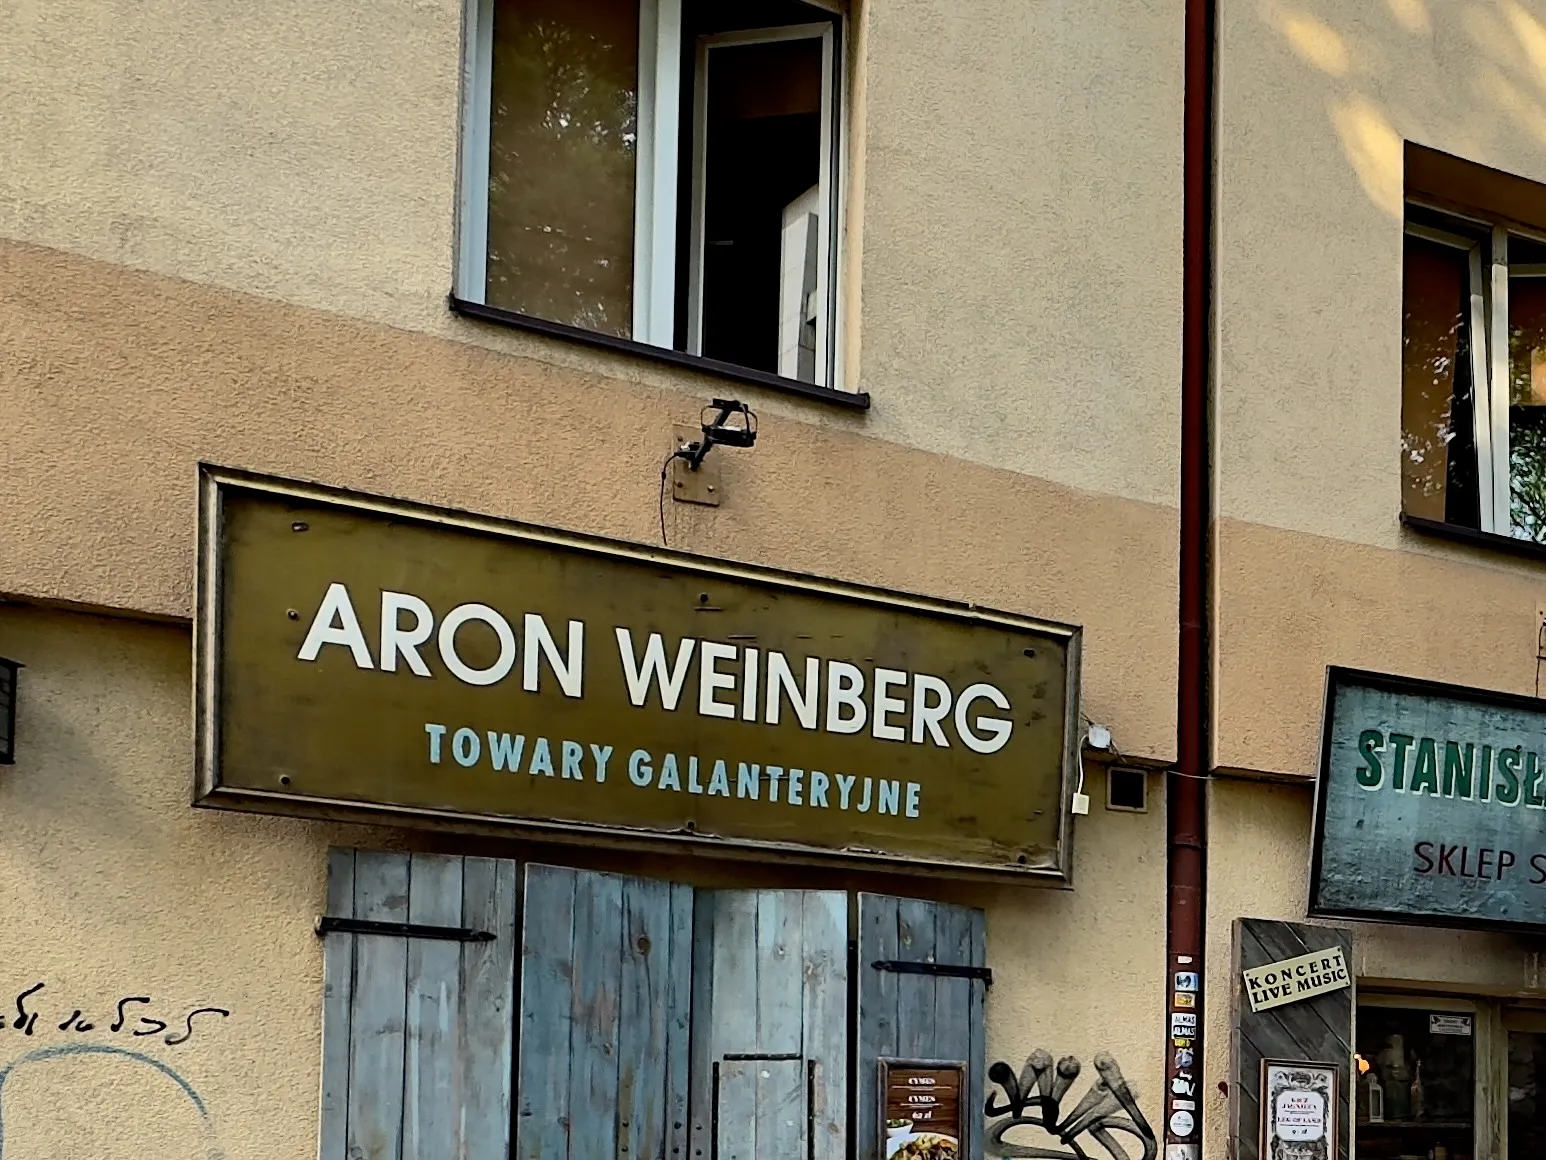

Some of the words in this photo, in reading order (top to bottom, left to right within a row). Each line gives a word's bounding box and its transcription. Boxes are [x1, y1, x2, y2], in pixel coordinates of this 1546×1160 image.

[297, 582, 584, 698] ARON
[615, 626, 1013, 754] WEINBERG
[424, 723, 613, 784] TOWARY
[628, 748, 922, 818] GALANTERYJNE
[1413, 842, 1515, 882] SKLEP
[1249, 955, 1342, 990] KONCERT
[1252, 983, 1292, 1004] LIVE
[1296, 968, 1347, 992] MUSIC
